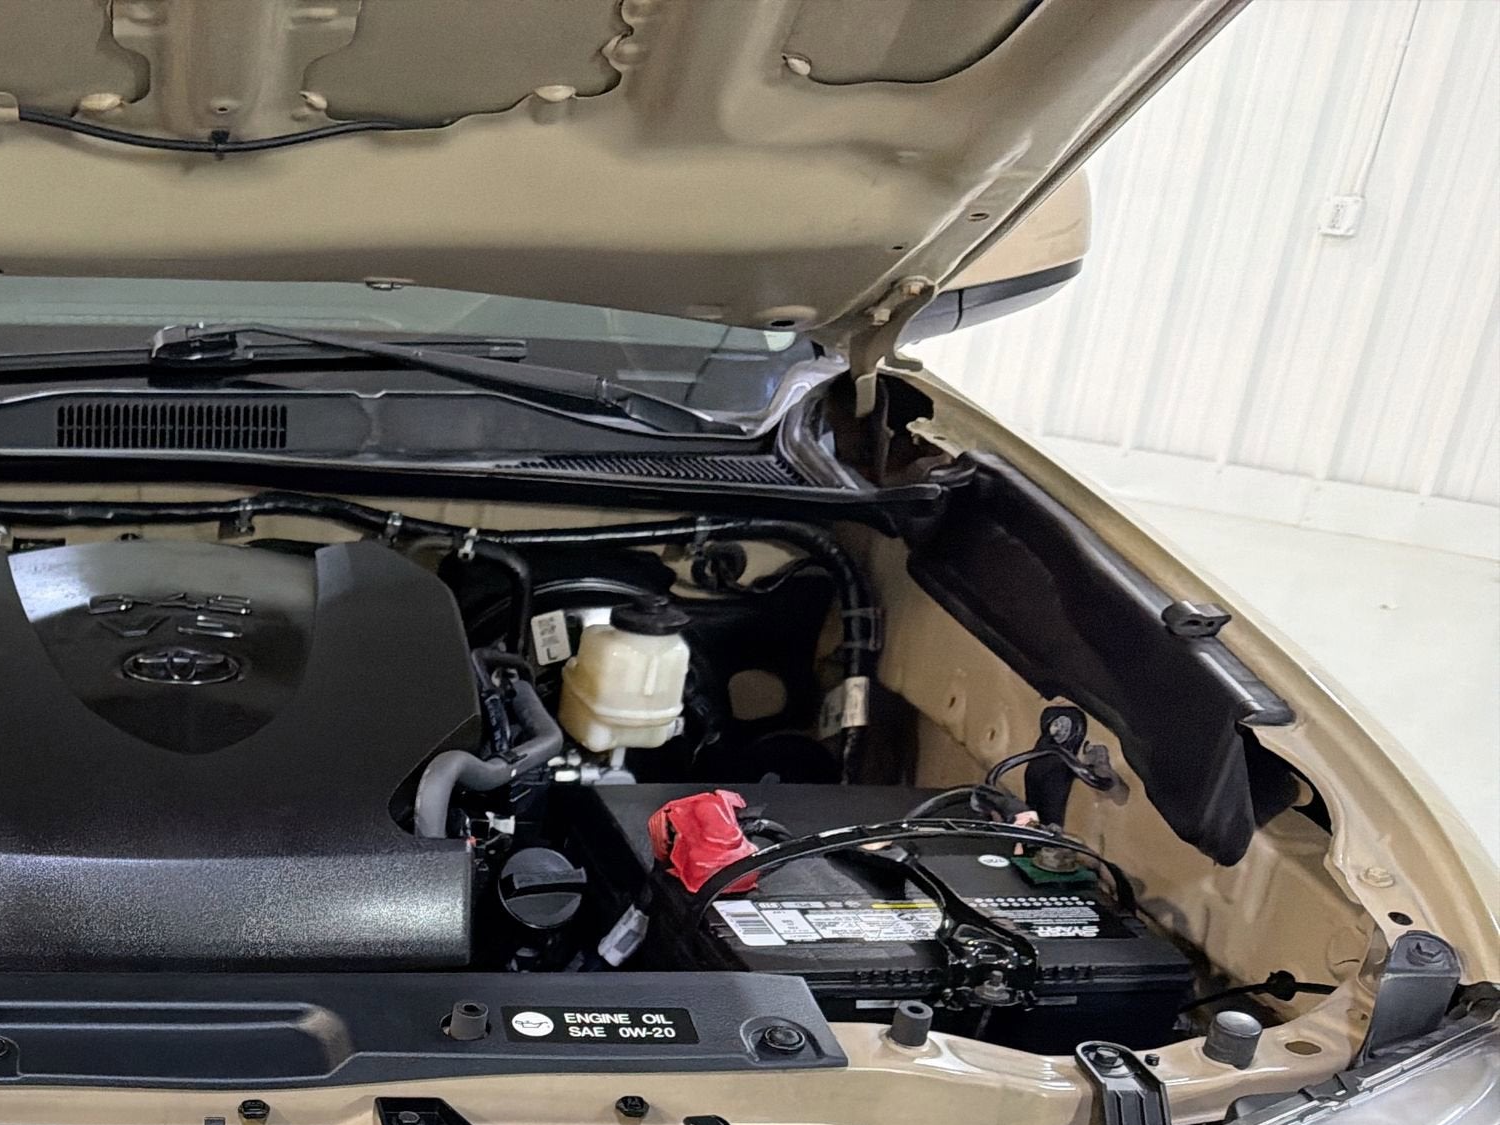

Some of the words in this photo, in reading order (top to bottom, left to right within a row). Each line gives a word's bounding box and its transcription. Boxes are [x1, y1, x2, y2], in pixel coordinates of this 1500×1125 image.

[563, 1012, 631, 1024] ENGINE
[642, 1013, 674, 1025] OIL
[568, 1026, 607, 1038] SAE
[618, 1026, 676, 1038] 0W-20
